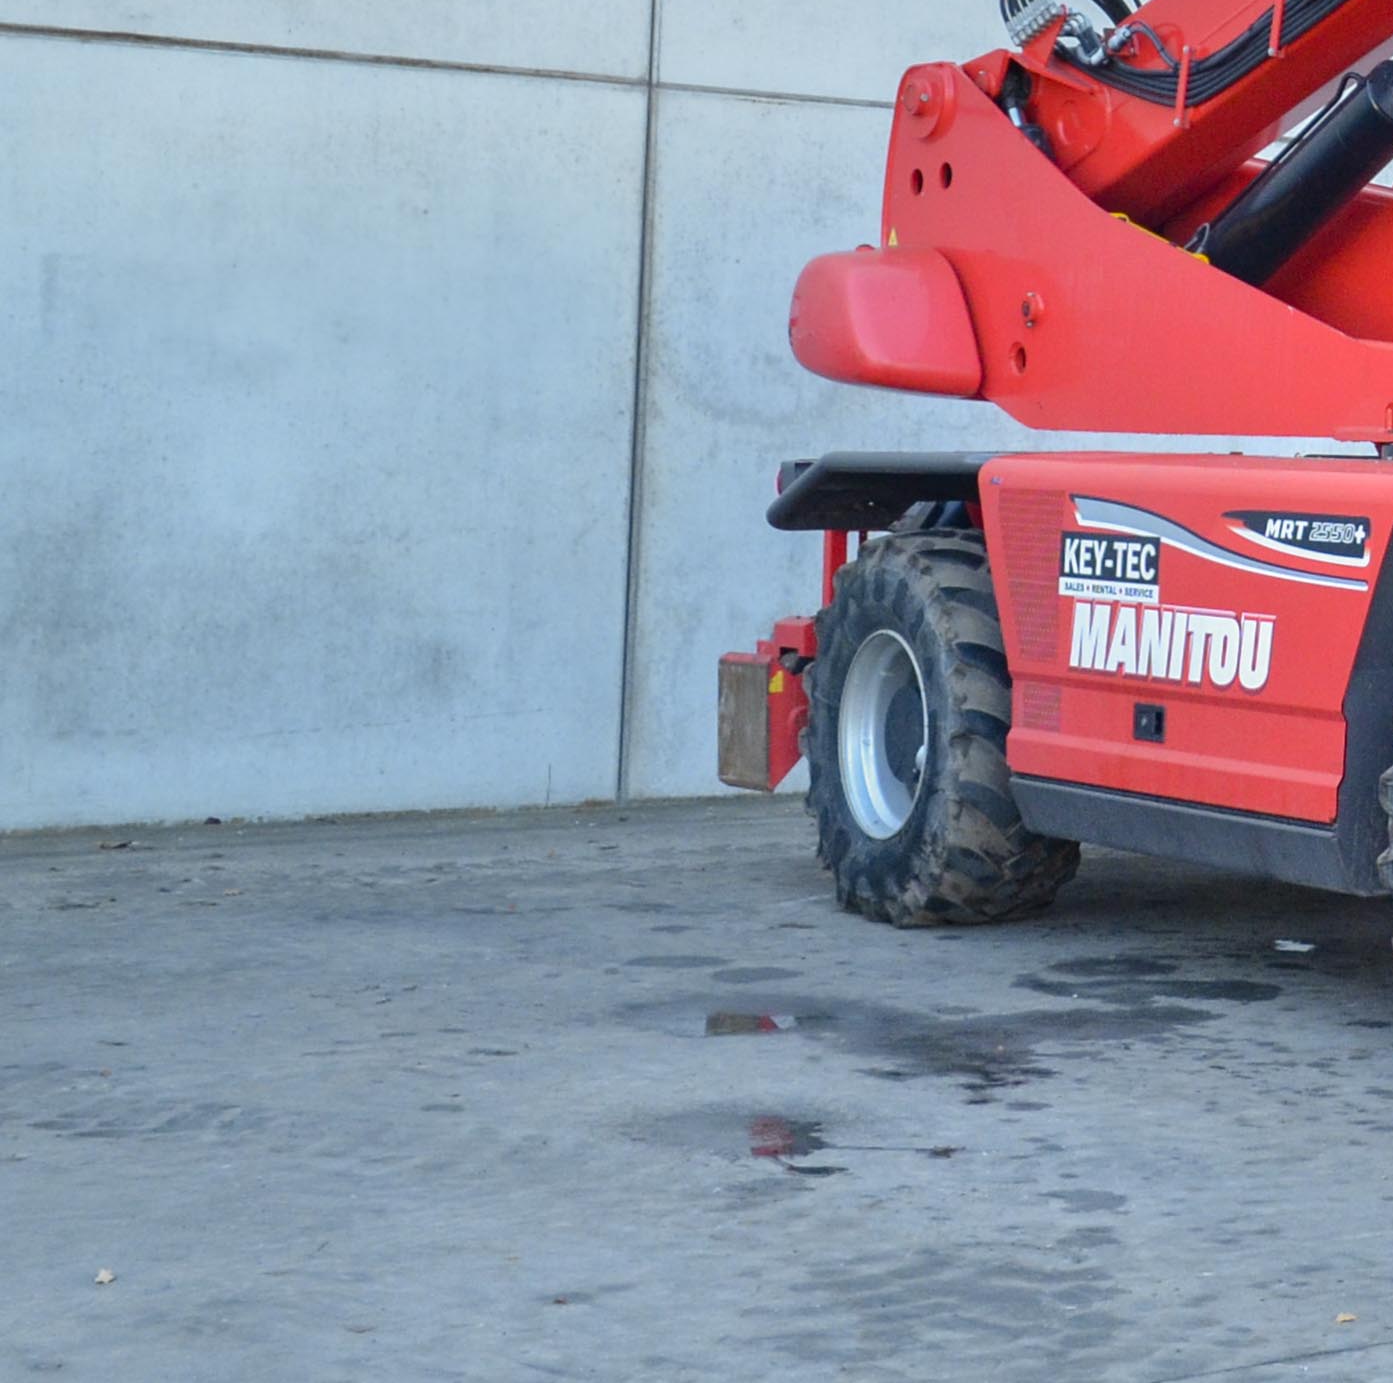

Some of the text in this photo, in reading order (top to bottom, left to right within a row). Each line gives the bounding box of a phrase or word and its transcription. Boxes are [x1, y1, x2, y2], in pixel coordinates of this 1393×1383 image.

[1265, 518, 1308, 540] MRT
[1063, 538, 1156, 581] KEY-TEC
[1064, 582, 1153, 598] SALES RENTAL SERVICE
[1069, 602, 1275, 691] MANITOU
